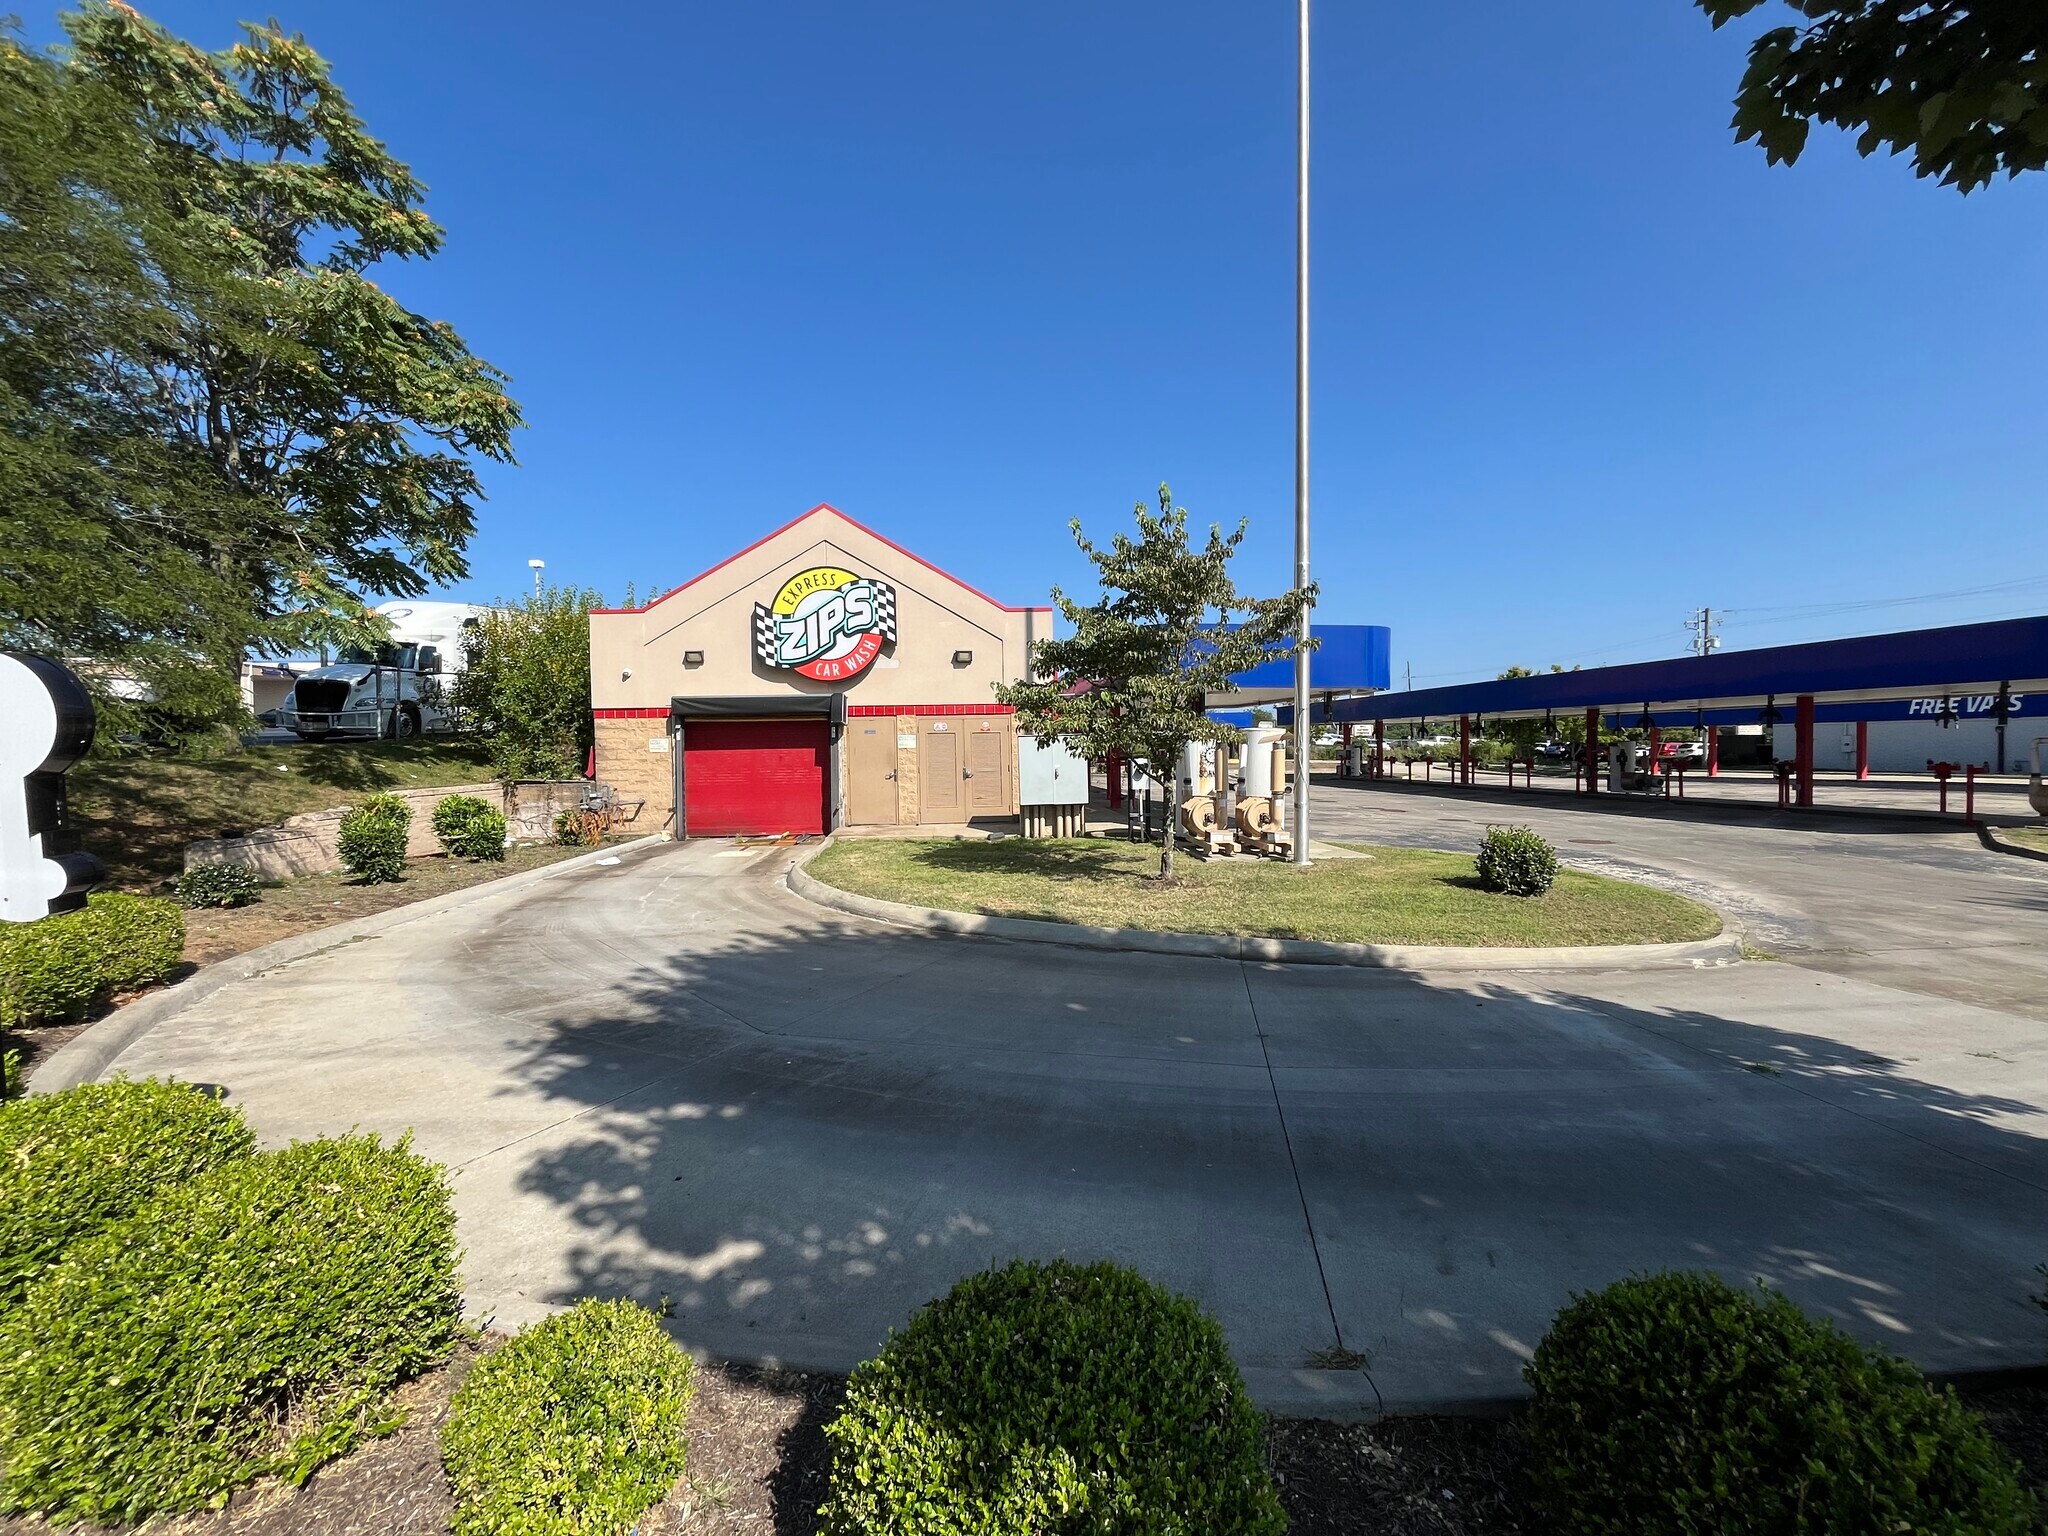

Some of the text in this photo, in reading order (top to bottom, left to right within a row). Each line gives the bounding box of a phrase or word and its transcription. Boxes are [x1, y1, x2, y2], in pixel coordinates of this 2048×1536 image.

[782, 573, 836, 605] EXPRESS
[779, 586, 874, 660] ZIPS
[815, 640, 877, 676] CAR WASH
[1909, 694, 2023, 714] FREE VAS
